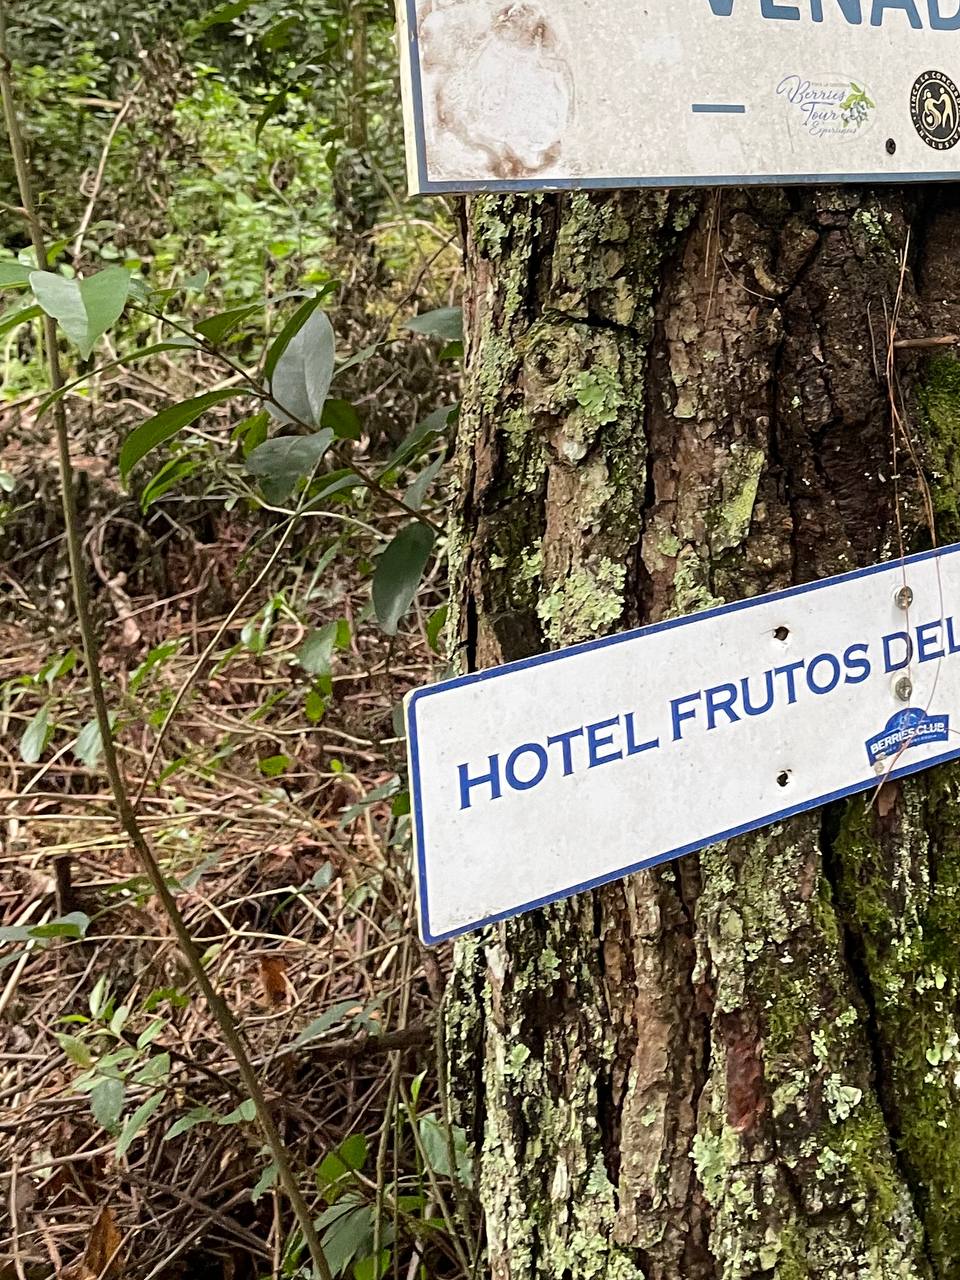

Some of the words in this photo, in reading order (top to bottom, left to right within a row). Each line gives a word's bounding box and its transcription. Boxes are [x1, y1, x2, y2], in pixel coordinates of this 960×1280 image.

[776, 75, 846, 104] Berries
[911, 83, 921, 114] FINCA
[920, 73, 929, 83] LA
[800, 101, 839, 127] Tour
[456, 712, 659, 810] HOTEL
[670, 642, 871, 741] FRUTOS
[870, 728, 915, 755] BERRIES
[916, 722, 946, 735] CLUB
